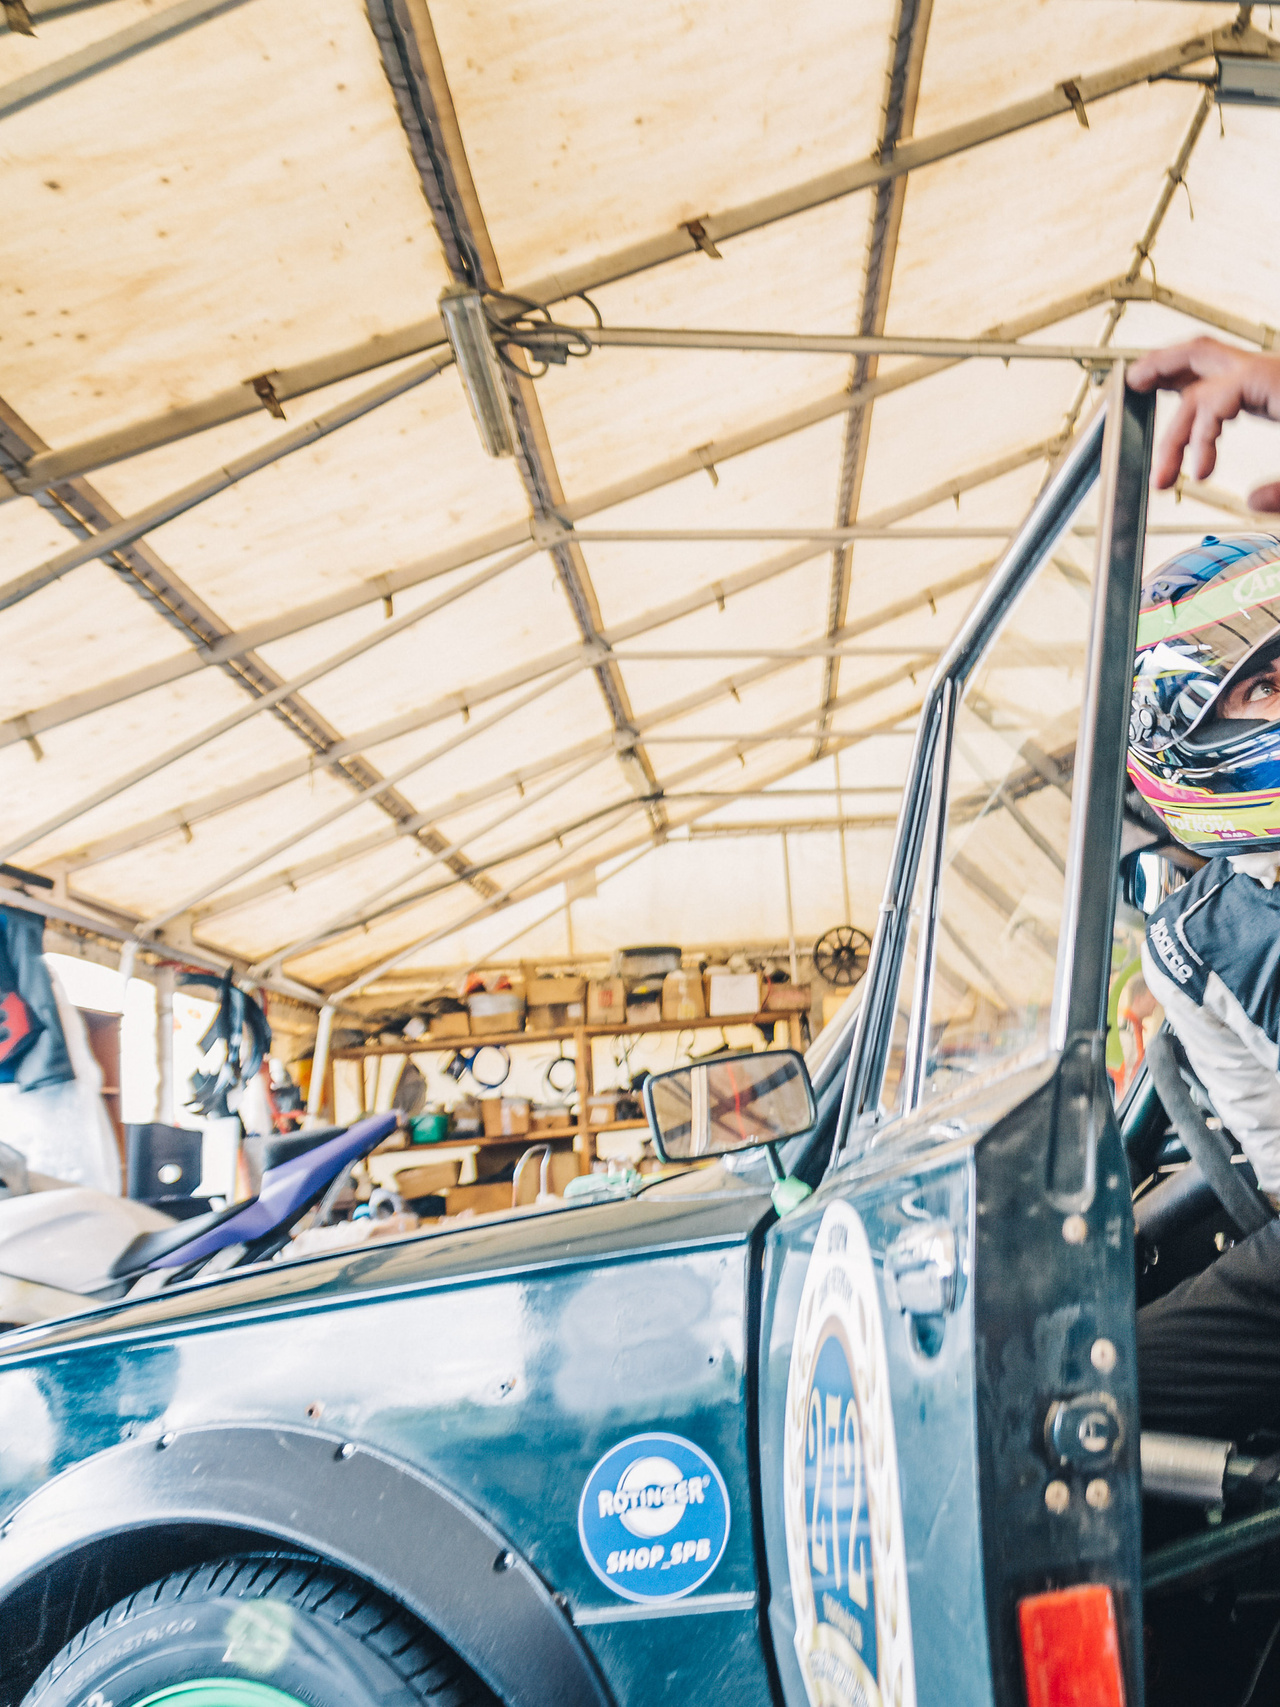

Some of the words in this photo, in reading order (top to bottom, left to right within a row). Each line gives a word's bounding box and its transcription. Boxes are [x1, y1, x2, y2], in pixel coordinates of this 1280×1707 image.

[1166, 815, 1236, 833] VOLKOVA
[1150, 918, 1193, 983] sparco
[809, 1387, 867, 1610] 272
[606, 1538, 711, 1574] SHOP_SPB
